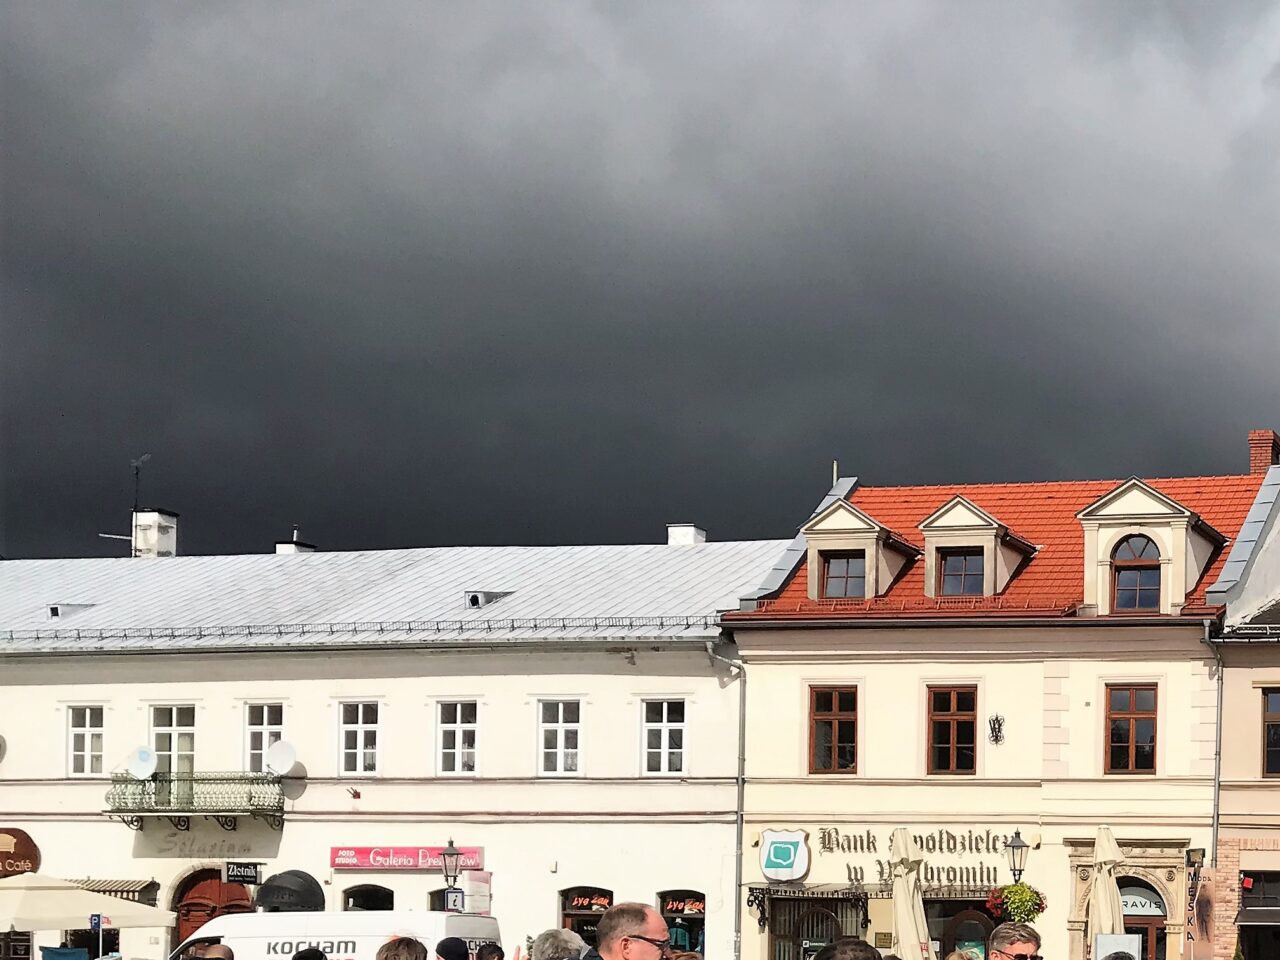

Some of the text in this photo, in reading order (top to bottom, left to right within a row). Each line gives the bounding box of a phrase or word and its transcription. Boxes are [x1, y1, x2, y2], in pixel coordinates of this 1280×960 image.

[818, 827, 1015, 858] Bank półdzielcz
[369, 848, 413, 866] Galeria
[5, 859, 33, 871] Café
[228, 864, 257, 877] Złotnik
[1122, 900, 1162, 909] RAVIS
